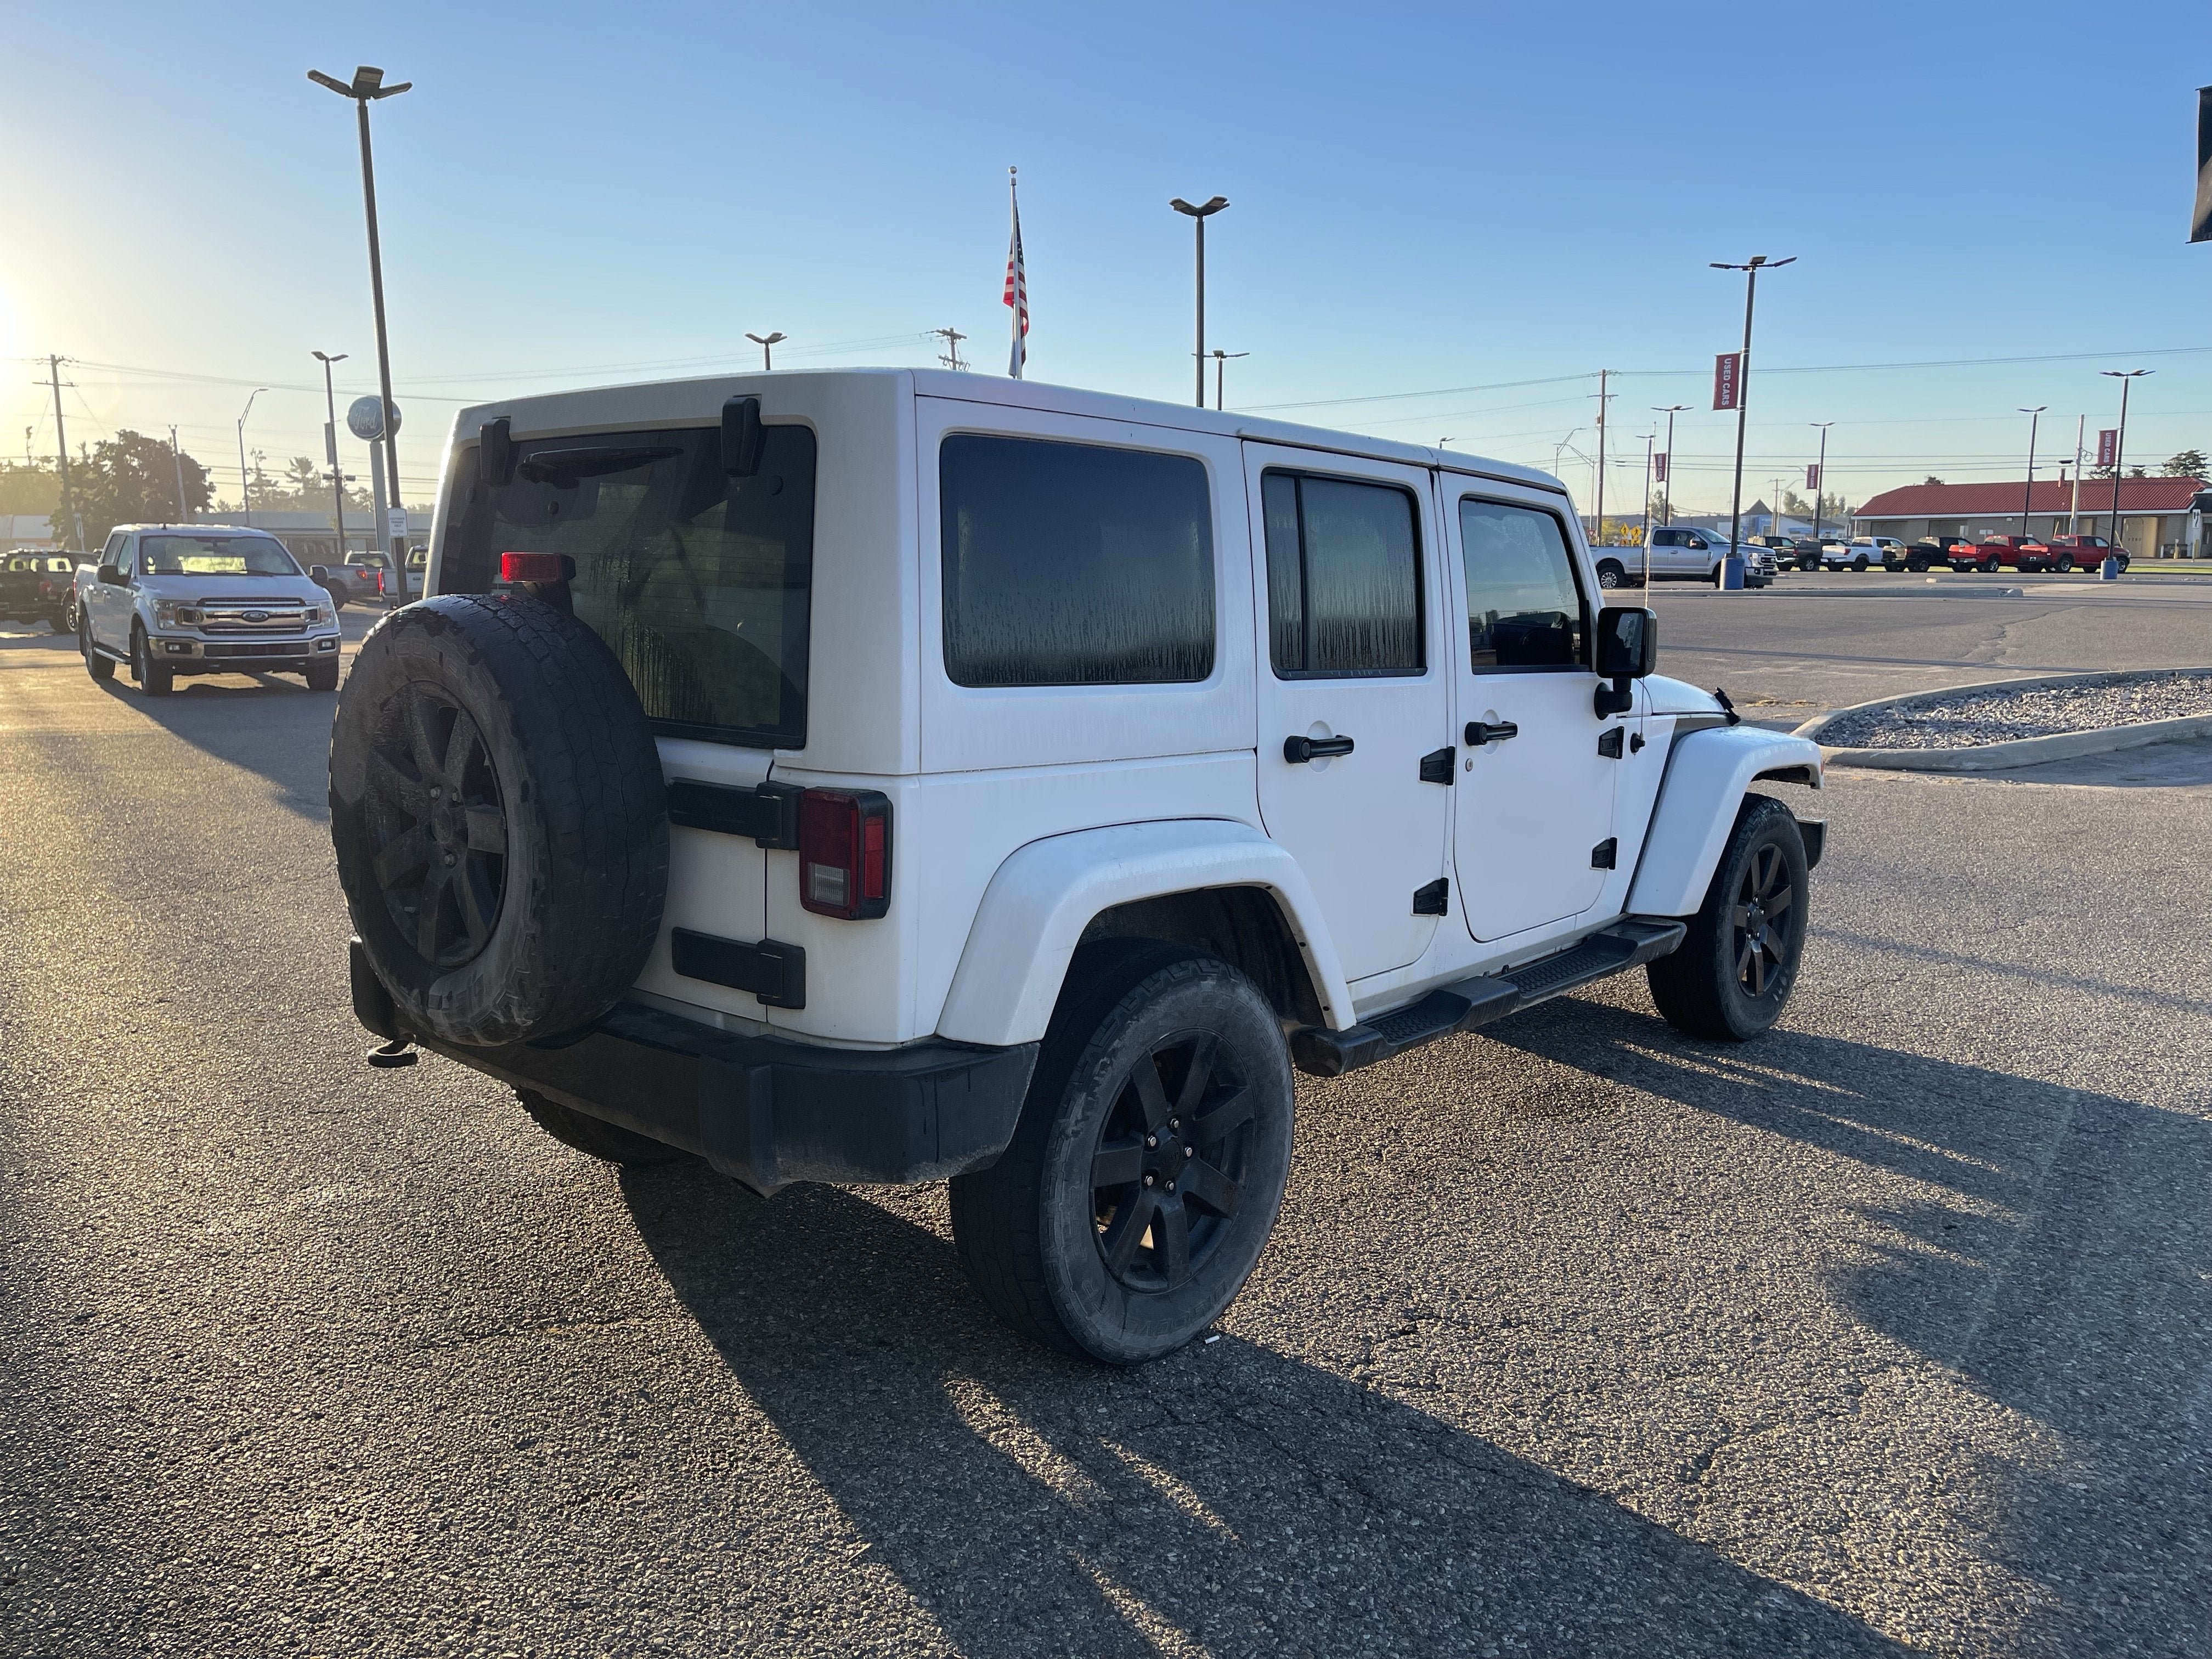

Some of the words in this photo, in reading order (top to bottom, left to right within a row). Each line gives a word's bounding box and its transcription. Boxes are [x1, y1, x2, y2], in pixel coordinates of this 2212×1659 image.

[1723, 358, 1732, 381] USED
[1722, 383, 1730, 406] CARS
[353, 406, 378, 430] Ford
[1196, 991, 1281, 1070] COOPER
